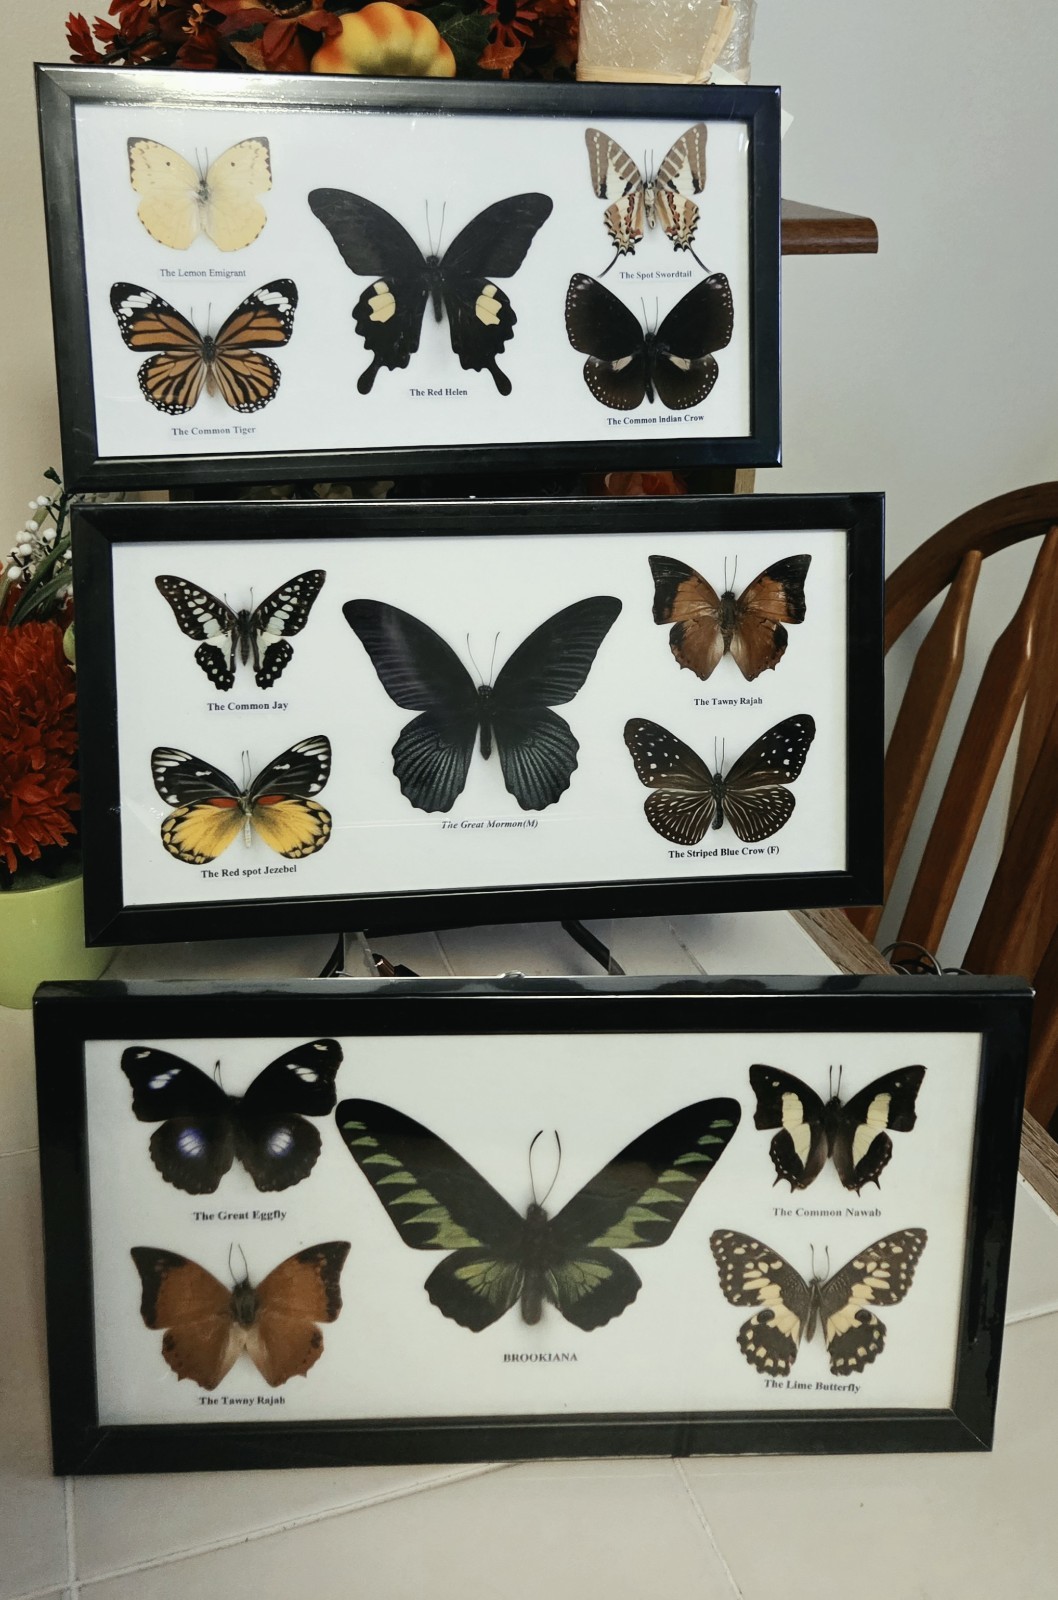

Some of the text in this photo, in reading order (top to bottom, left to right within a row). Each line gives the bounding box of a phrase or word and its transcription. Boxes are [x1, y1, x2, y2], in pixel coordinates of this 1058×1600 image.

[159, 268, 247, 280] The Lemon Emigrant
[619, 269, 692, 281] The Spot Swordtail
[409, 387, 468, 397] The Red Helen
[607, 413, 705, 426] The Common Indian Crow
[171, 425, 257, 437] The Common Tiger
[206, 700, 289, 712] The Common Jay
[693, 696, 763, 707] The Tawny Rajah
[441, 820, 459, 830] The
[460, 820, 485, 829] Great
[667, 845, 780, 859] The Striped Blue Crow (F)
[200, 864, 297, 879] The Red spot Jezebel
[192, 1209, 287, 1222] The Great Eggfly
[772, 1207, 882, 1217] The Common Nawab
[503, 1352, 578, 1363] BROOKIANA
[764, 1378, 861, 1394] The Lime Butterfly
[198, 1395, 286, 1407] The Tawny Rajah
